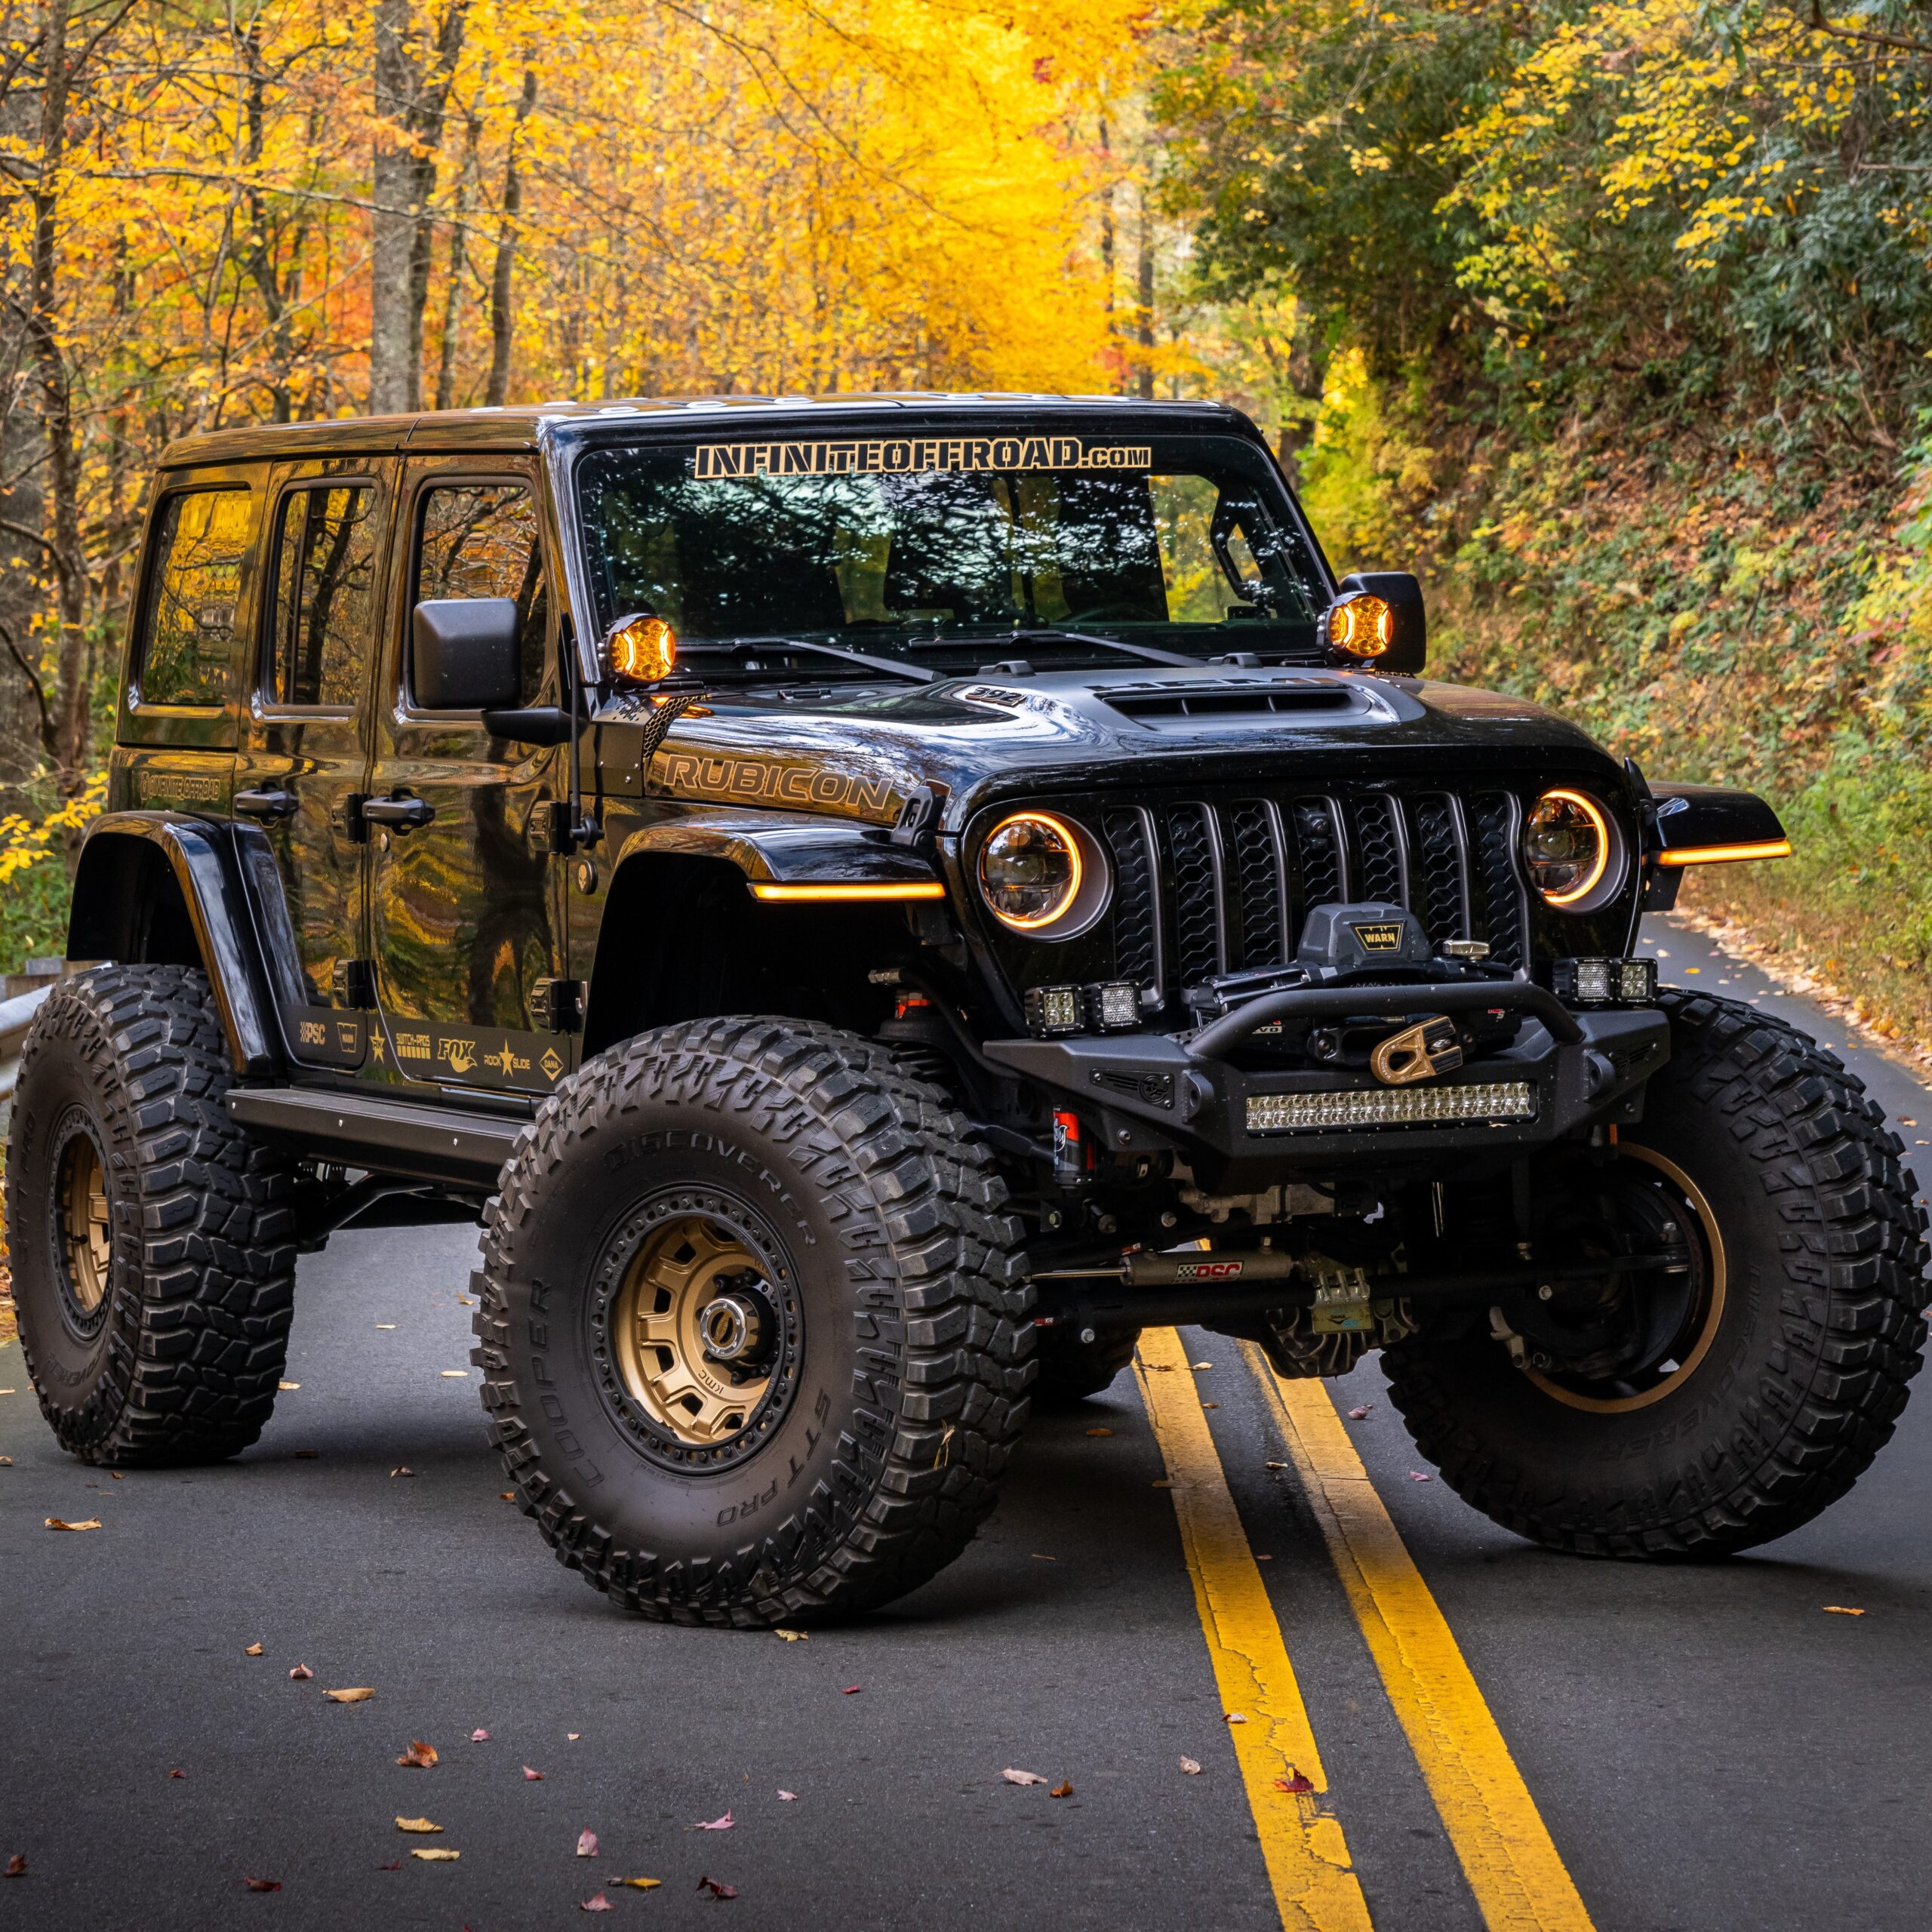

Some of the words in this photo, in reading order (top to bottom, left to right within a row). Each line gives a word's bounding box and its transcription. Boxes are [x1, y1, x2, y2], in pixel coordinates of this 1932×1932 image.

[965, 686, 1026, 707] 392
[663, 755, 894, 810] RUBICON
[1364, 933, 1395, 943] WARN
[306, 1022, 325, 1045] PSC
[438, 1038, 476, 1060] FOX
[604, 1128, 817, 1246] DISCOVERER
[528, 1277, 605, 1488] COOPER
[717, 1477, 778, 1527] PRO
